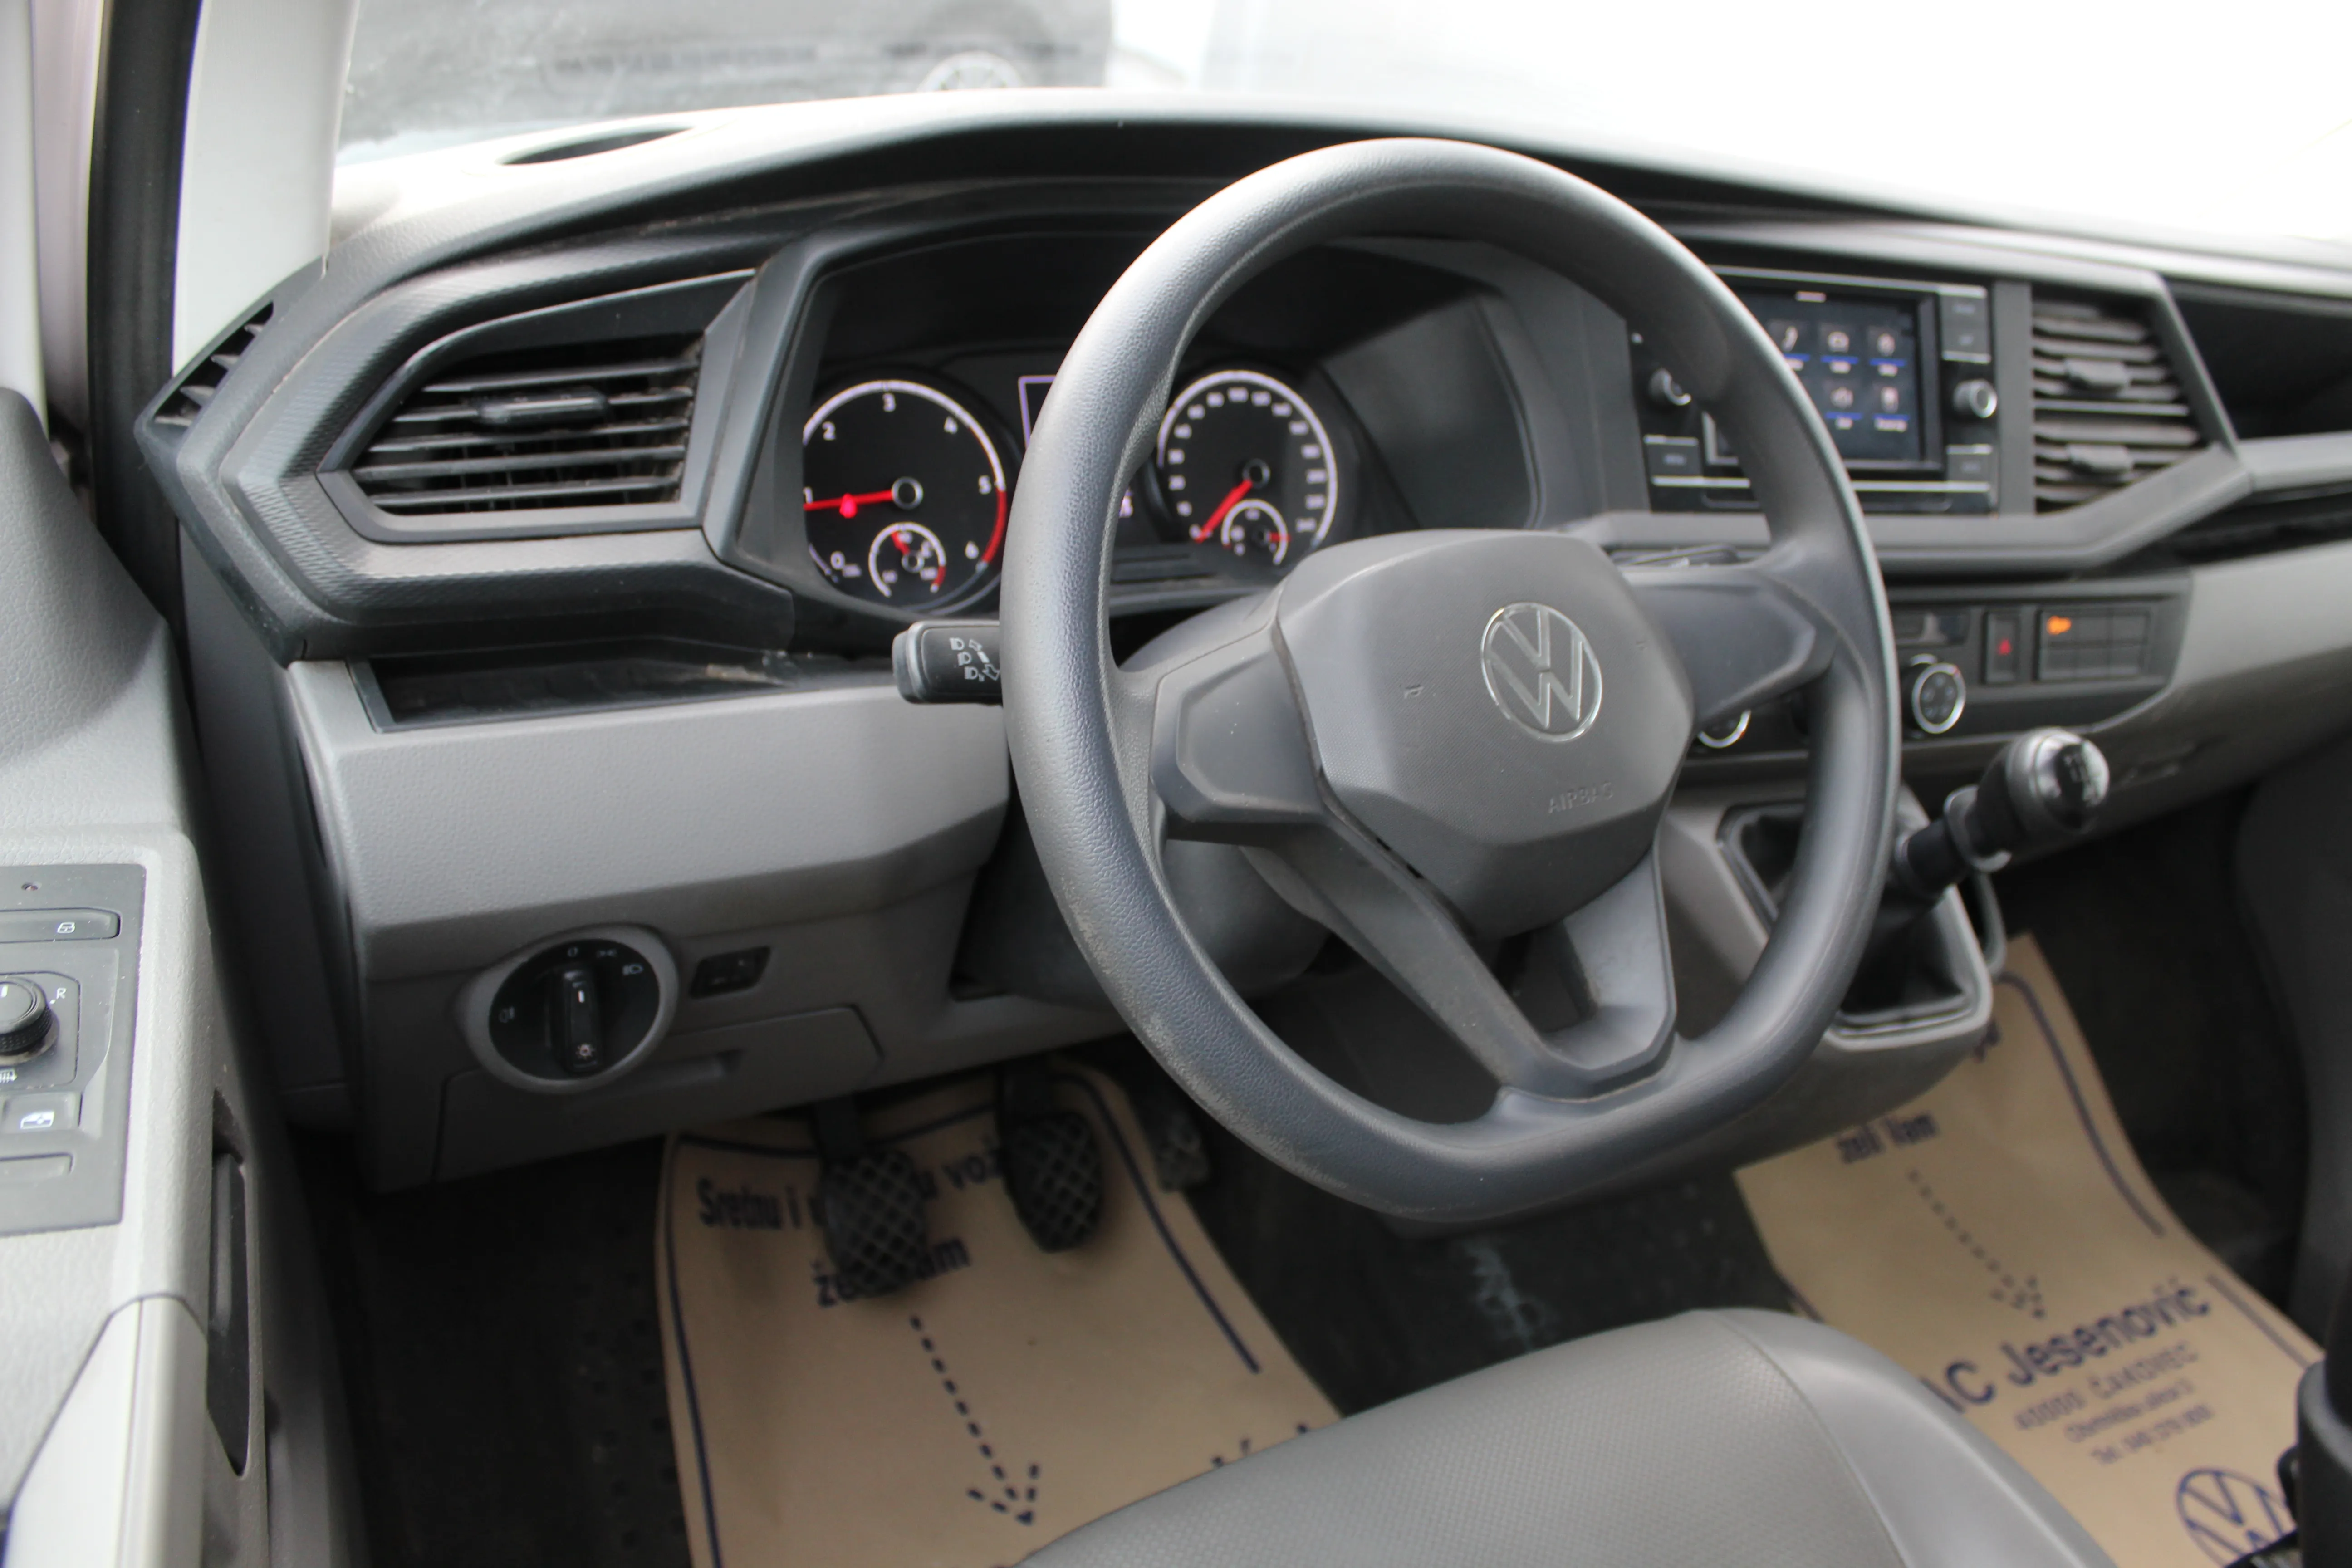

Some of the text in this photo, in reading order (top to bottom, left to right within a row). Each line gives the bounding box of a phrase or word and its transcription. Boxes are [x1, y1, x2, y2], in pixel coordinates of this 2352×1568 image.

[883, 393, 896, 412] 3
[823, 421, 836, 440] 2
[944, 417, 958, 434] 4
[979, 475, 991, 494] 5
[803, 487, 813, 503] 1
[965, 541, 979, 559] 6
[831, 551, 845, 570] 0
[56, 987, 66, 1000] R
[2002, 1276, 2210, 1386] Jesenović
